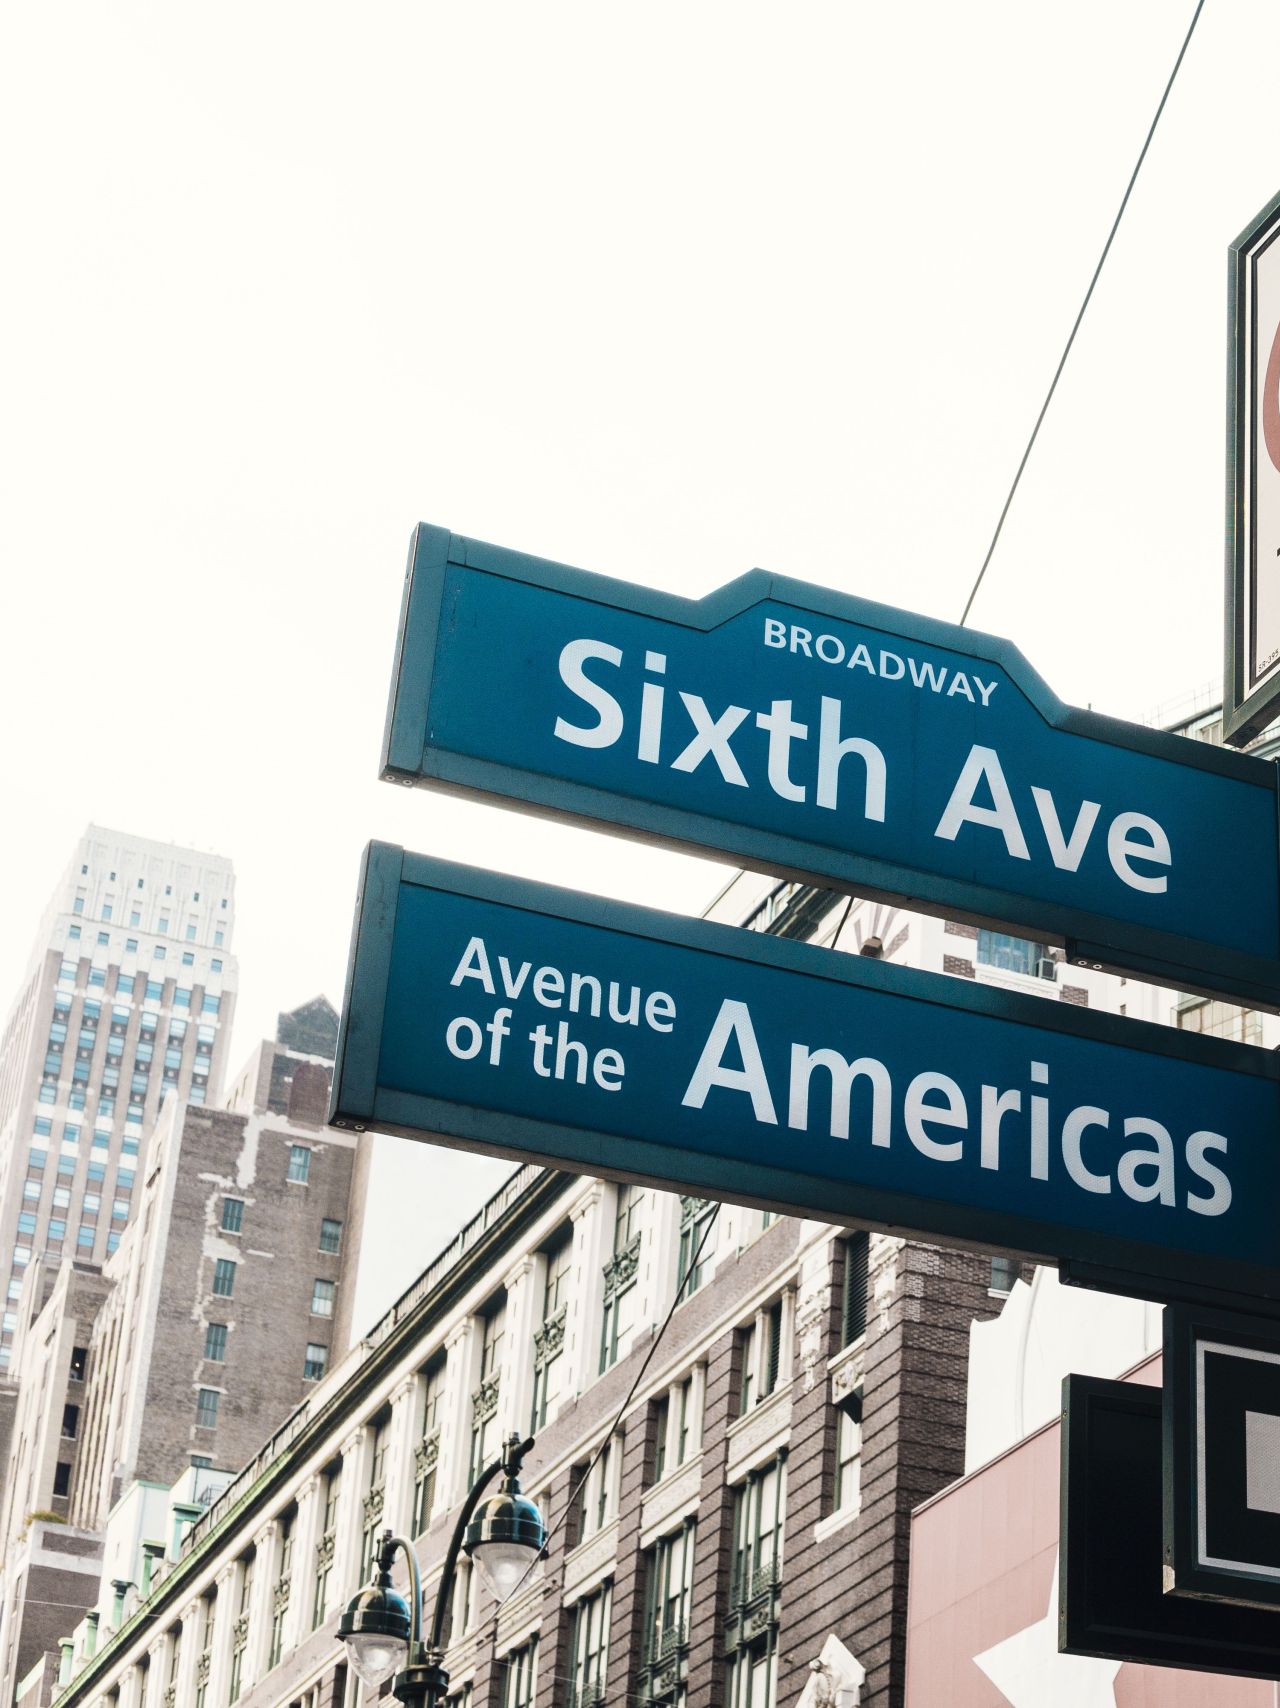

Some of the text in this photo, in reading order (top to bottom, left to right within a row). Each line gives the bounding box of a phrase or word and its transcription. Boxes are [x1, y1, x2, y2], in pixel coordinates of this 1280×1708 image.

[763, 617, 999, 707] BROADWAY
[553, 638, 1172, 894] Sixth Ave
[449, 936, 677, 1033] Avenue
[445, 1007, 625, 1092] of the
[681, 998, 1232, 1216] Americas
